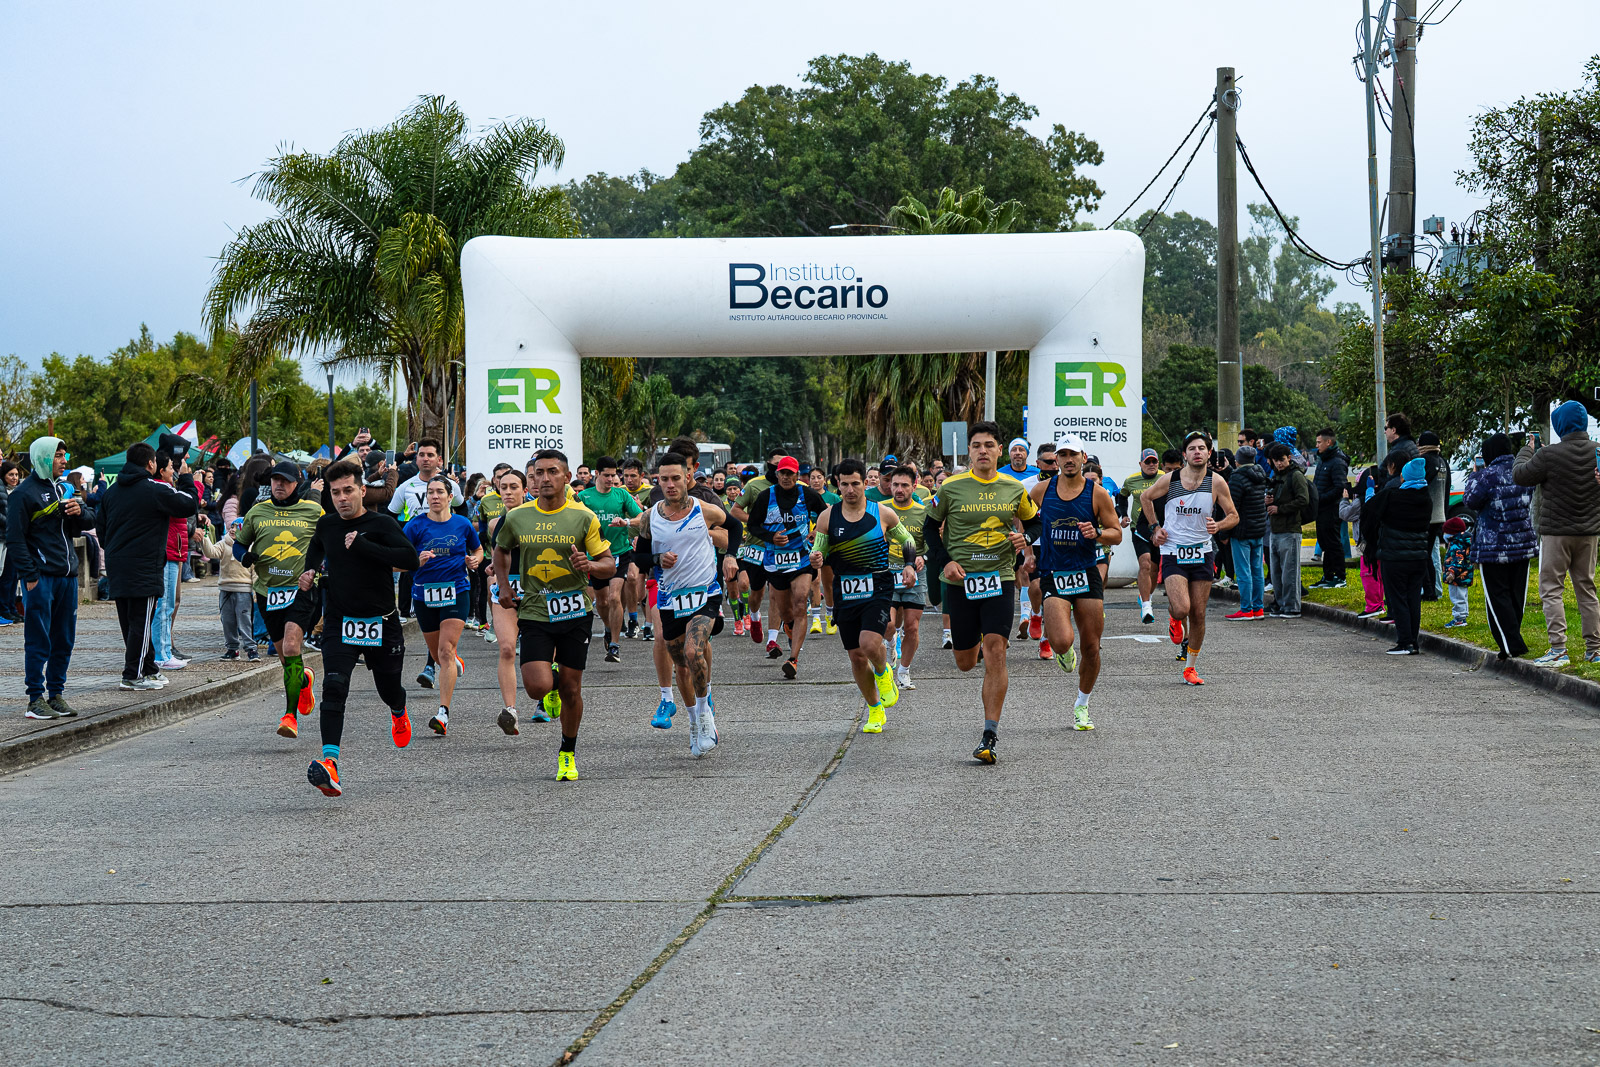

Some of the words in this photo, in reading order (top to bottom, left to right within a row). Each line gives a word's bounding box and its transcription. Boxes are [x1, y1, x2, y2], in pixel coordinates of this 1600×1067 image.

[770, 263, 856, 282] Instituto
[729, 263, 889, 309] Becario
[766, 313, 813, 321] AUTÁRQUICO
[487, 367, 562, 414] ER
[1054, 361, 1127, 408] ER
[487, 424, 547, 435] GOBIERNO
[549, 424, 563, 435] DE
[1053, 417, 1113, 427] GOBIERNO
[1114, 417, 1127, 428] DE
[488, 438, 531, 450] ENTRE
[534, 435, 564, 450] RÍOS
[1100, 428, 1128, 443] RÍOS
[960, 503, 1014, 512] ANIVERSARIO
[258, 519, 309, 529] ANIVERSARIO
[519, 534, 576, 544] ANIVERSARIO
[1050, 529, 1080, 540] FARTLEK
[776, 551, 799, 565] 044
[1178, 546, 1202, 559] 095
[843, 576, 869, 594] 021
[966, 574, 998, 594] 034
[1056, 572, 1085, 590] 048
[269, 589, 296, 606] 037
[426, 586, 454, 602] 114
[675, 590, 705, 611] 117
[549, 593, 582, 616] 035
[551, 614, 572, 622] DIAMANTE
[344, 620, 379, 640] 036
